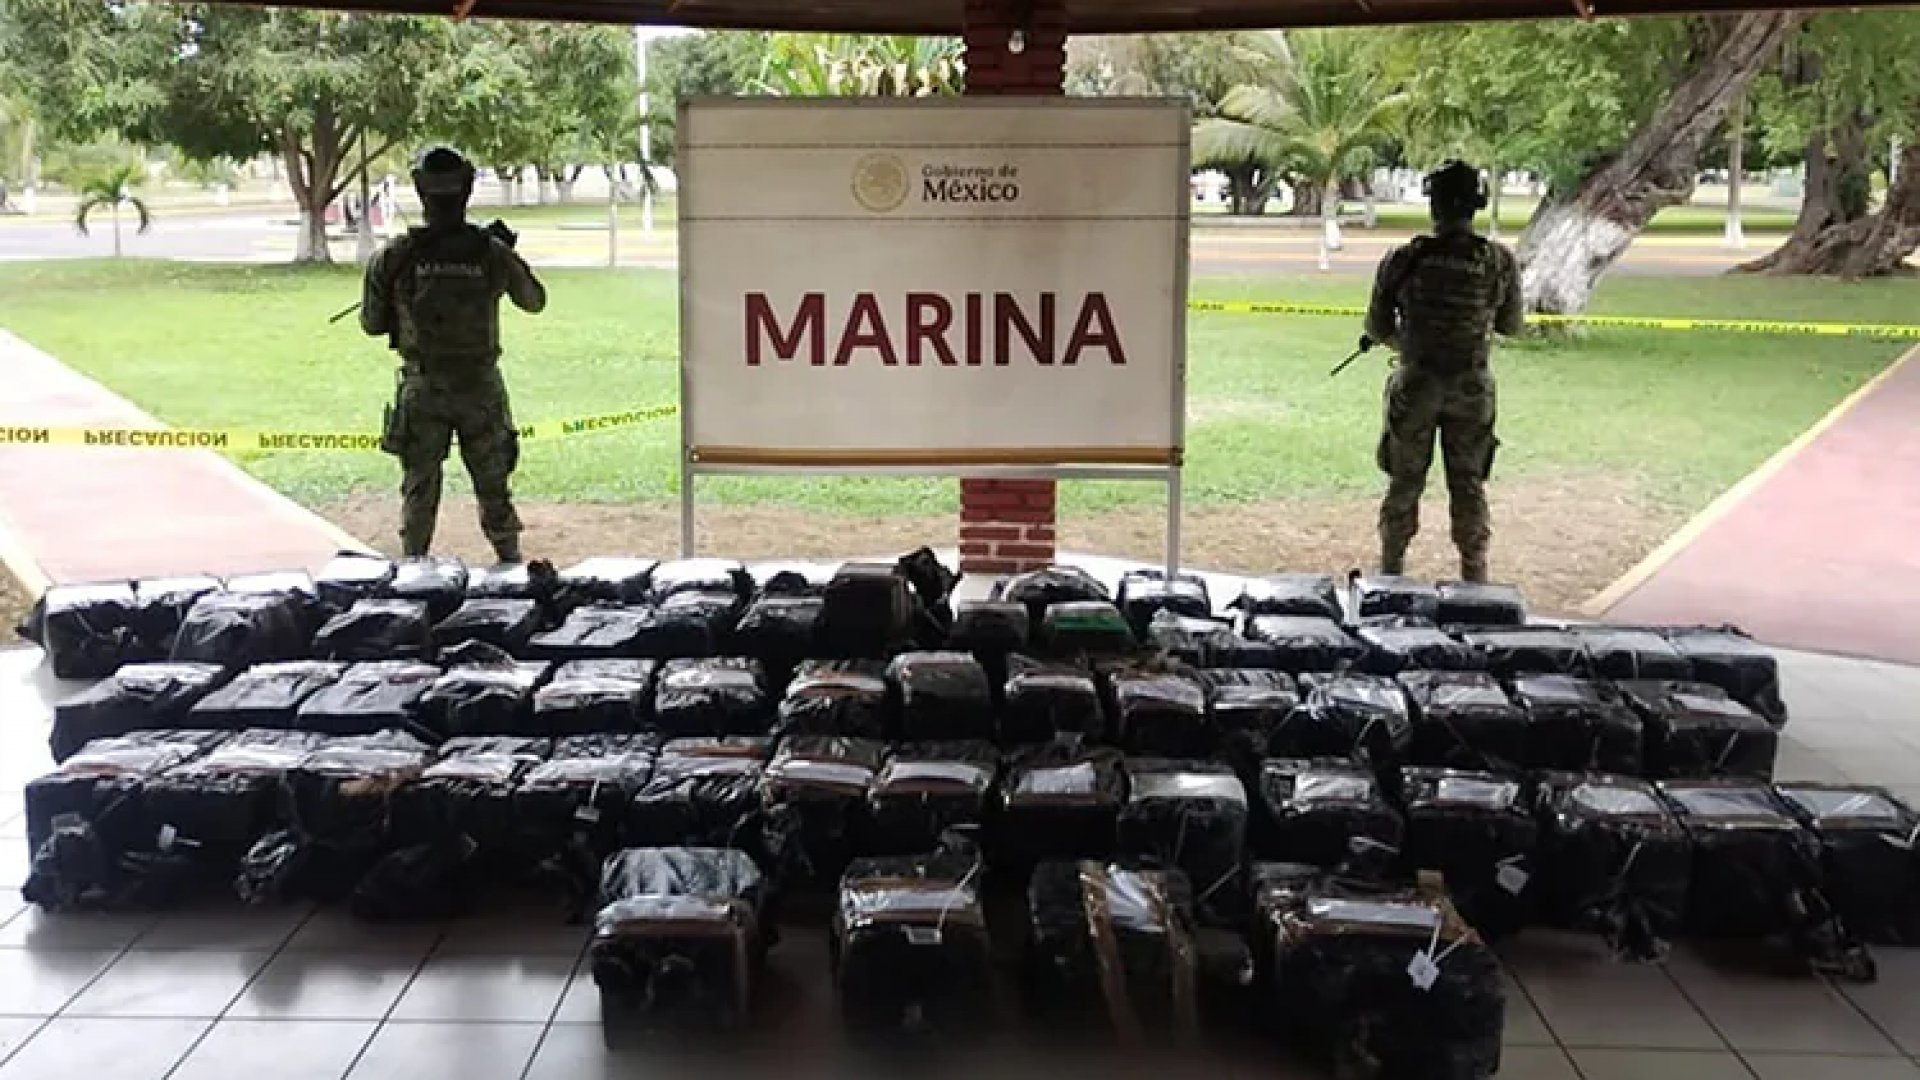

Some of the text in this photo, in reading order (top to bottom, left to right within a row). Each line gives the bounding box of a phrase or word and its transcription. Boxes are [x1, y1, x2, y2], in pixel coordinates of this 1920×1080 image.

[922, 163, 1018, 177] Gobierno de
[923, 177, 1020, 202] México
[744, 291, 1127, 366] MARINA
